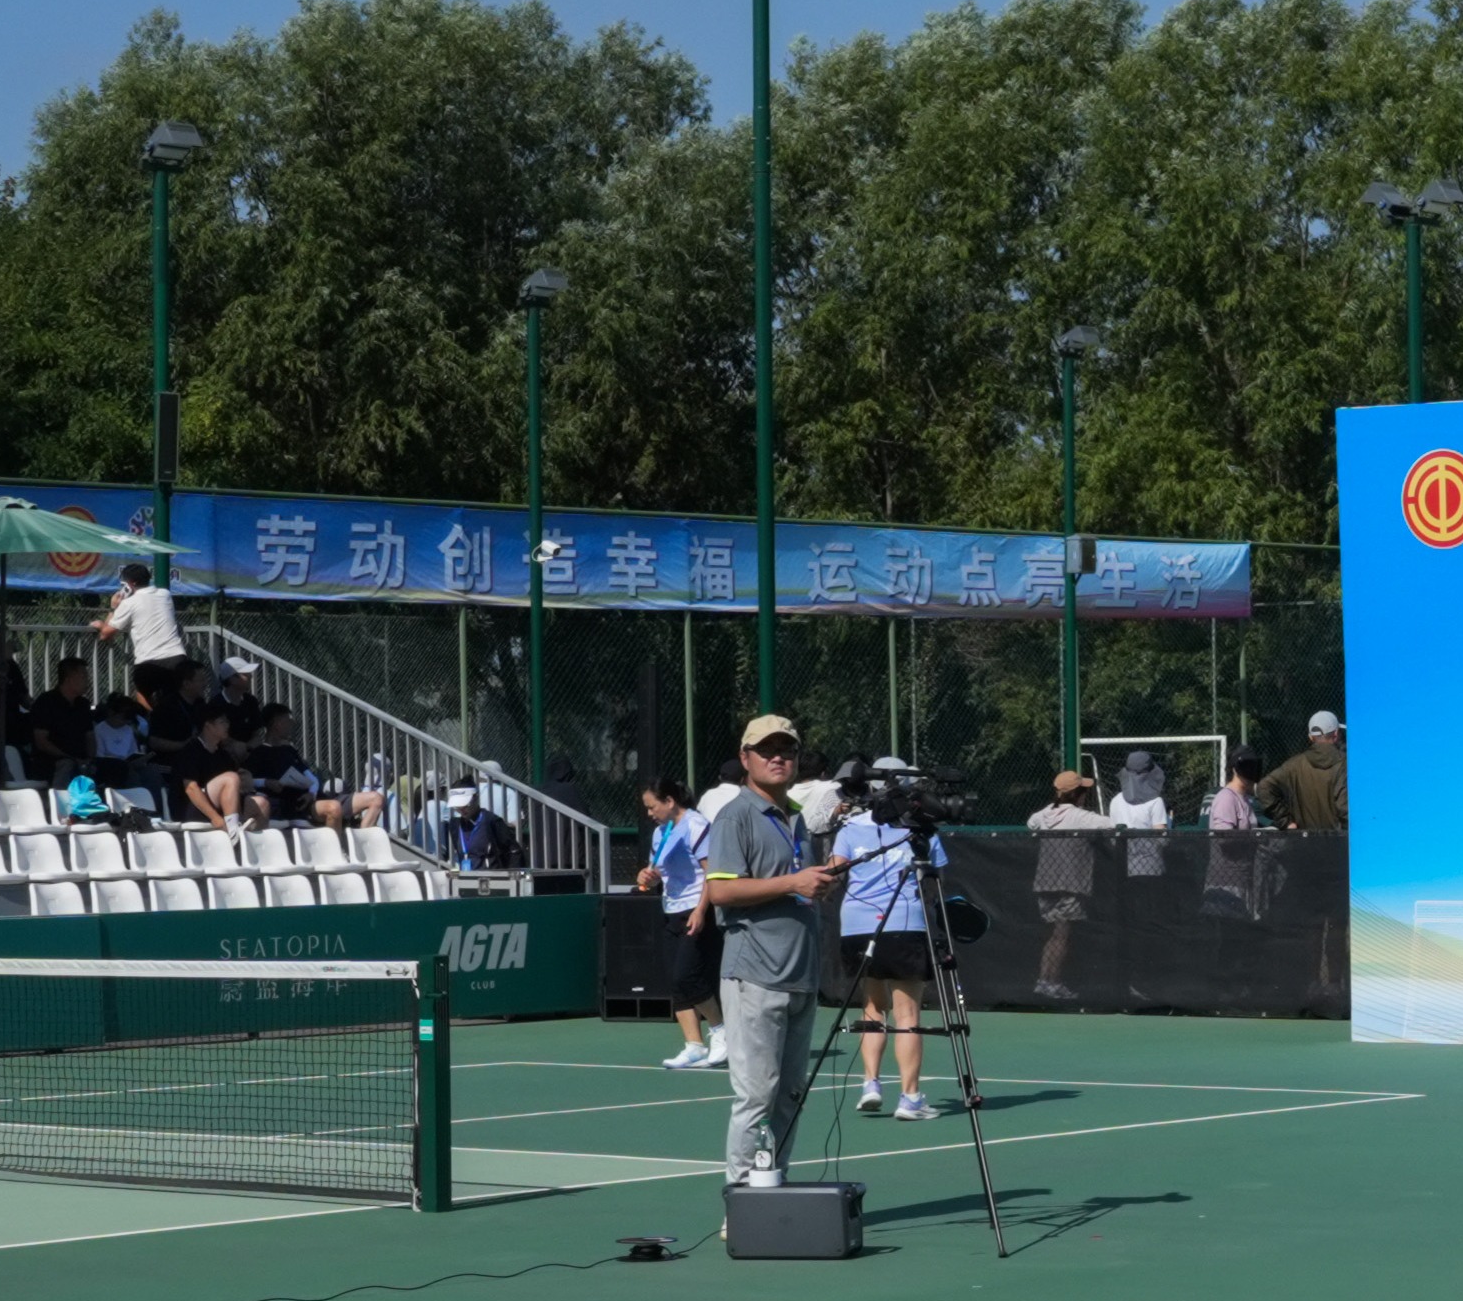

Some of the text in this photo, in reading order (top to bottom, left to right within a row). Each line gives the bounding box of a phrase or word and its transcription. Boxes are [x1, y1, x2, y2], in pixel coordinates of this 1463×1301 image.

[256, 514, 1202, 611] 劳动创造幸福 运动点亮生活
[220, 934, 346, 960] SEATOPIA
[438, 922, 528, 973] AGTA
[470, 980, 496, 990] CLUB
